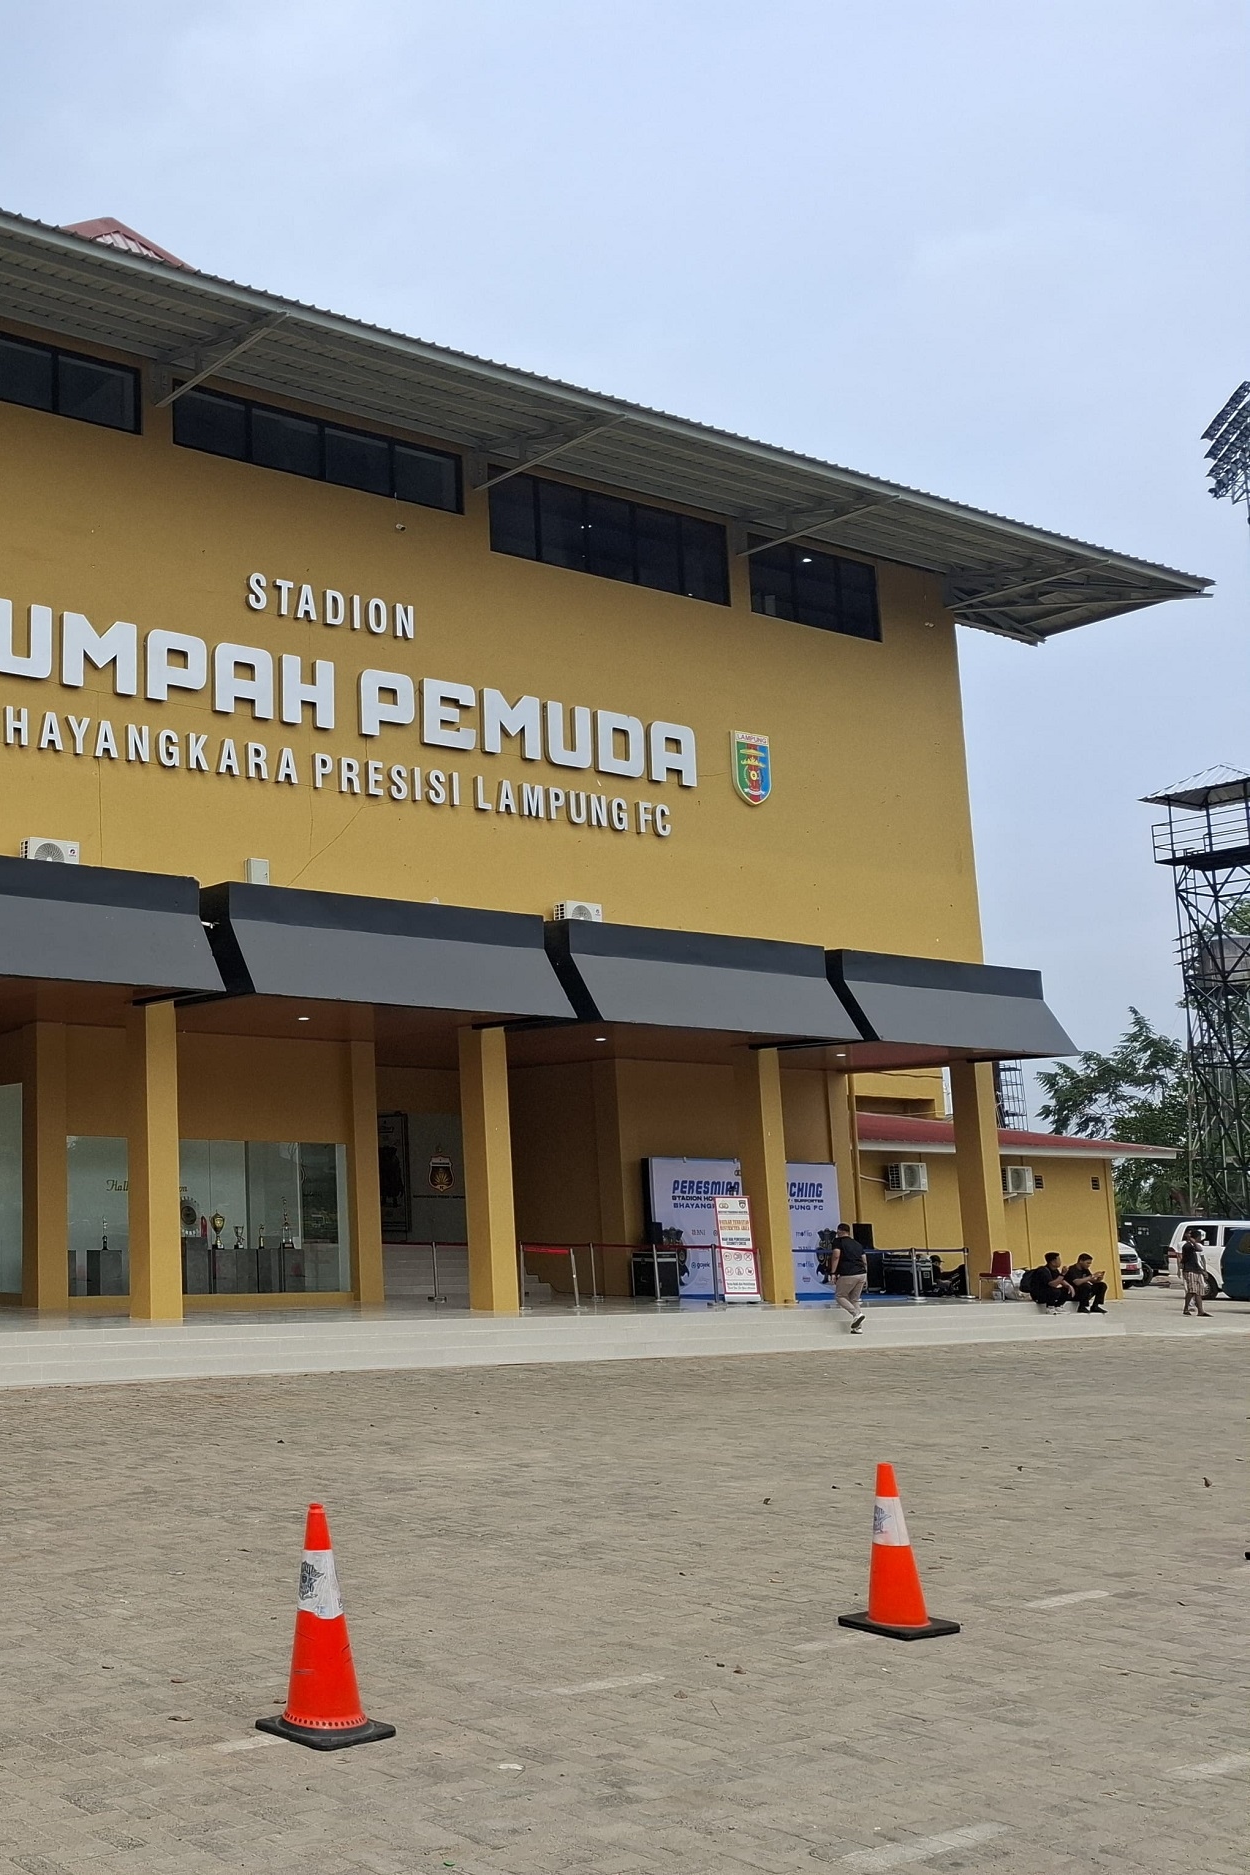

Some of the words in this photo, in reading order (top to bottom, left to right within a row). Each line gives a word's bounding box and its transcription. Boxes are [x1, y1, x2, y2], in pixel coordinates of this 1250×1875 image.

[245, 571, 416, 640] STADION
[358, 668, 698, 787] PEMUDA
[737, 734, 766, 744] LAMPUNG
[311, 751, 461, 807] PRESISI
[473, 774, 630, 832] LAMPUNG
[635, 800, 672, 838] FC
[787, 1182, 823, 1198] CHING
